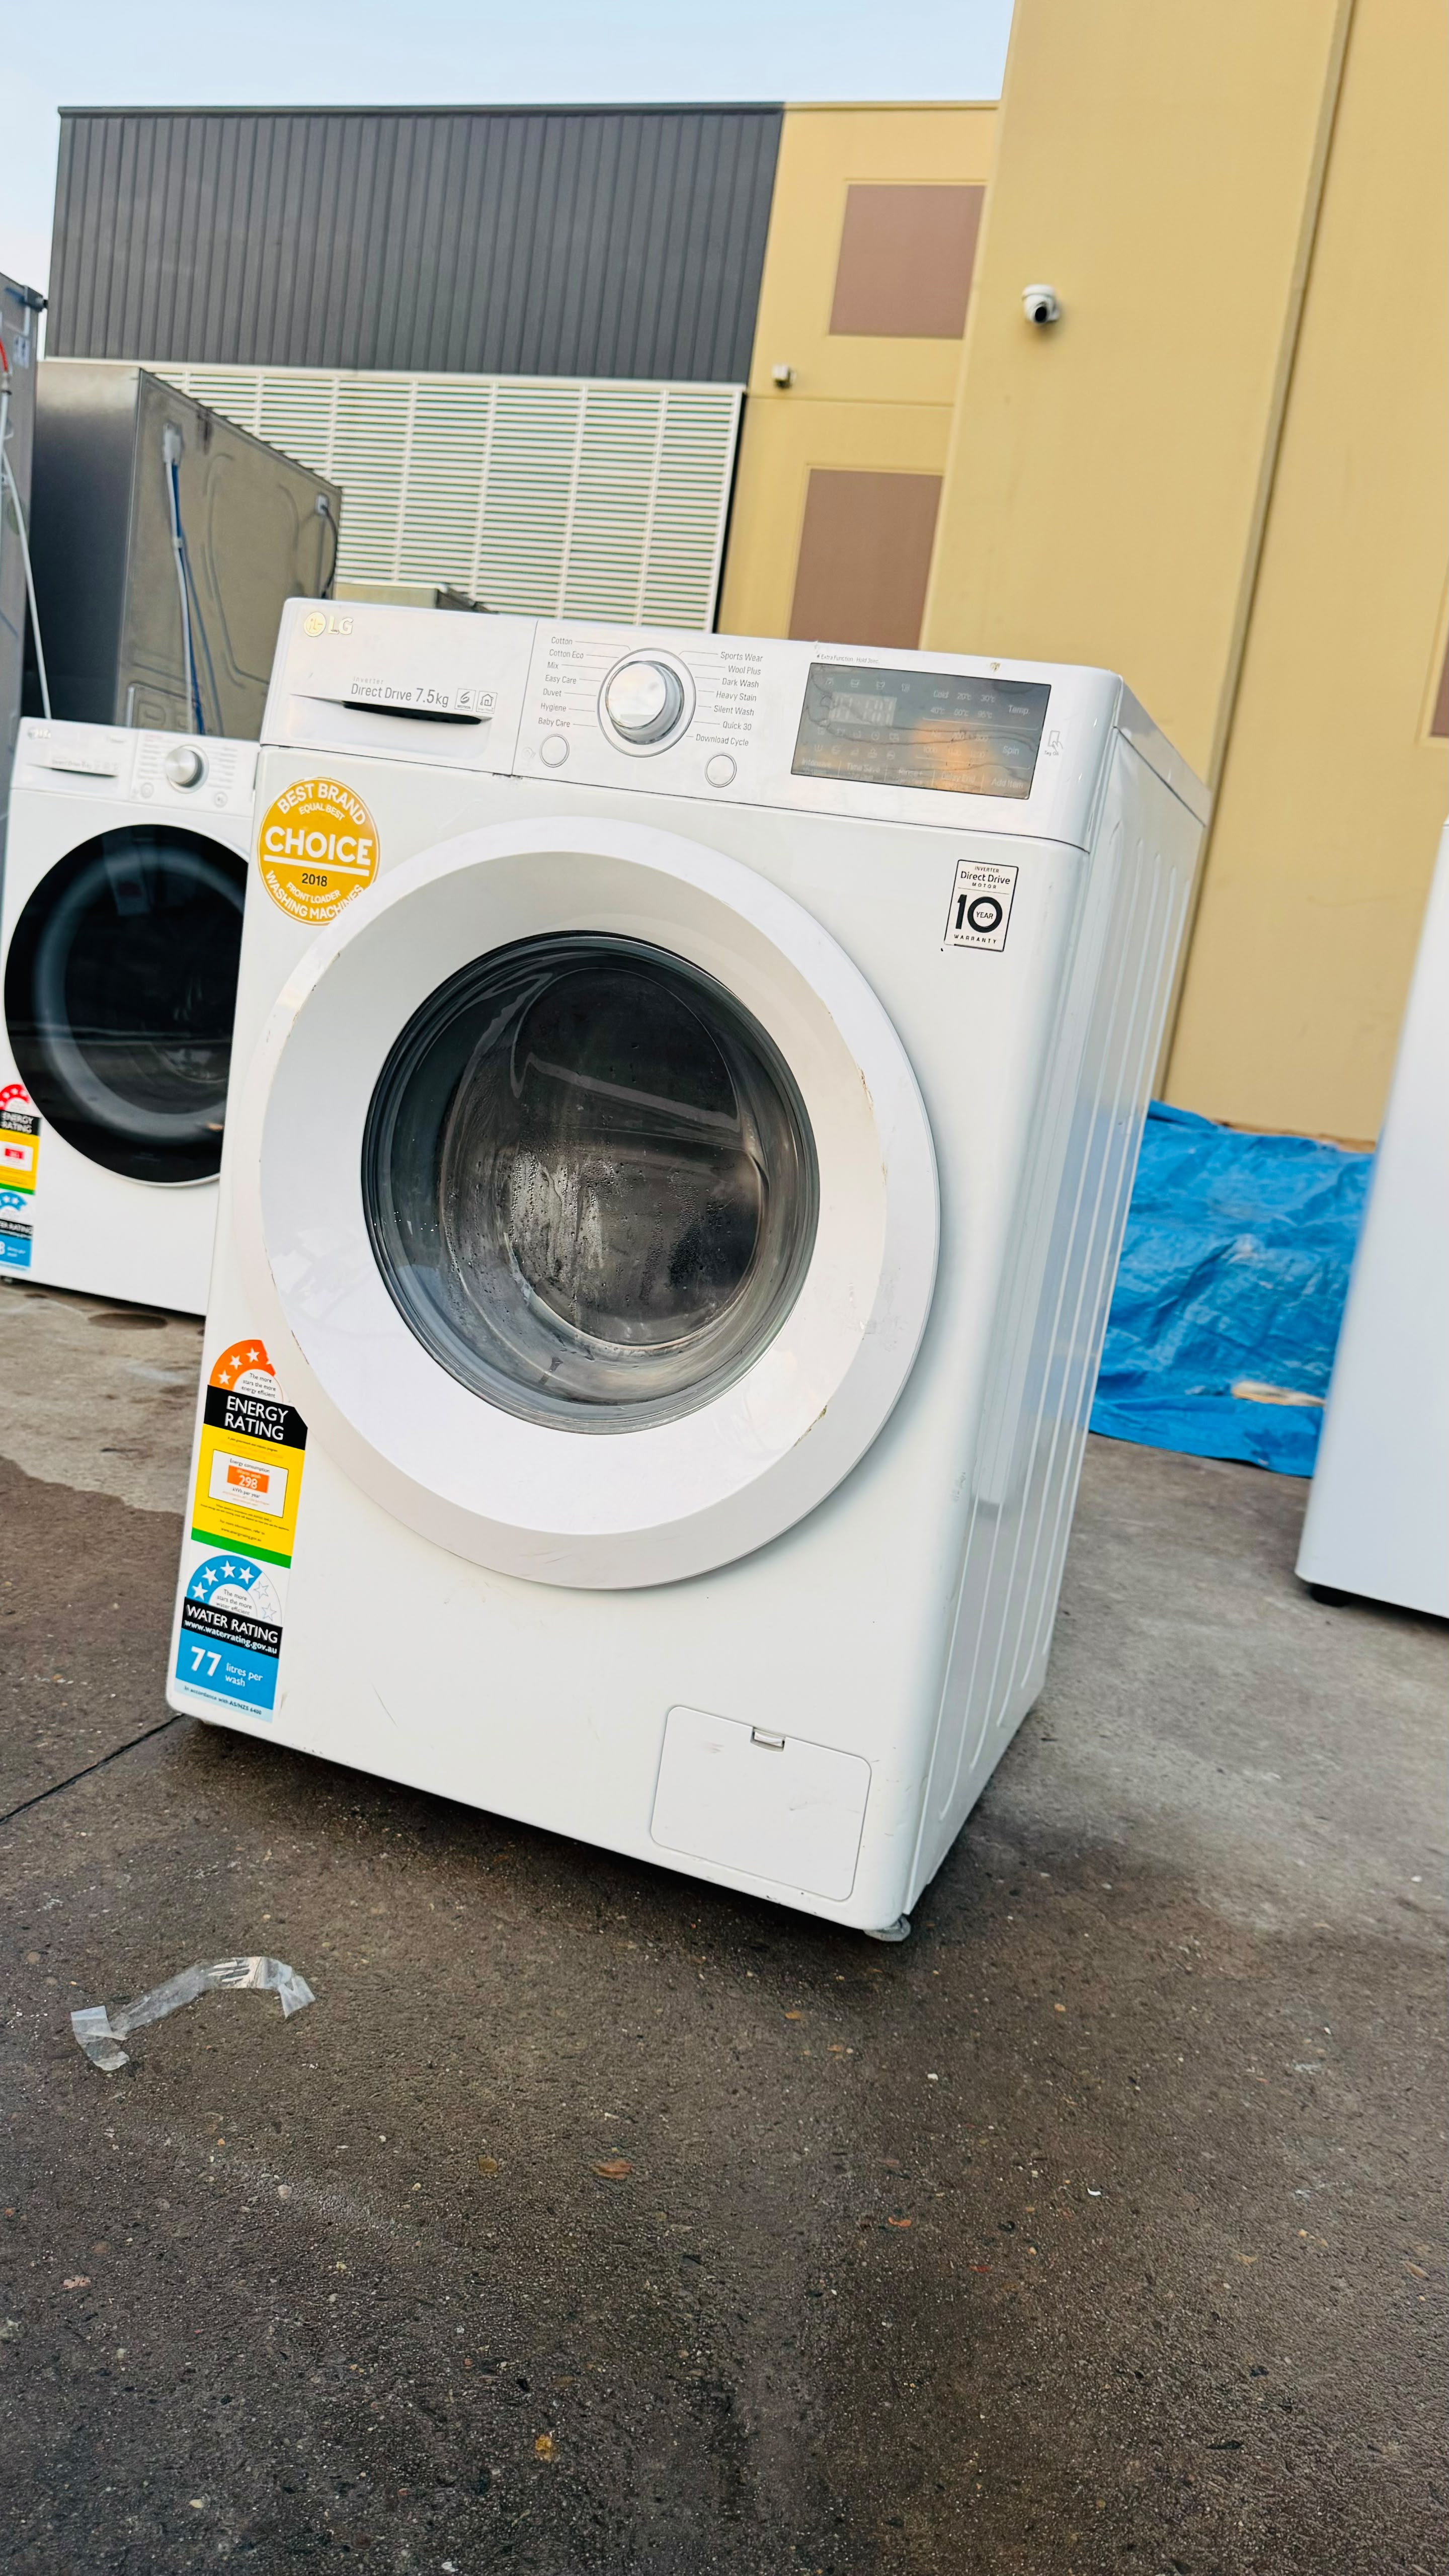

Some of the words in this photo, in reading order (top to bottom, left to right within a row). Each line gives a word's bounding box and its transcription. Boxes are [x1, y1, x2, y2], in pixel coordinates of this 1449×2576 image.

[328, 615, 354, 635] LG
[551, 637, 573, 645] Cotton
[549, 649, 571, 658] Cotton
[720, 652, 743, 661] Sports
[745, 654, 763, 662] Wear
[728, 665, 745, 674] Wool
[747, 667, 761, 675] Plus
[545, 675, 560, 683] Easy
[562, 676, 577, 684] Care
[722, 678, 738, 686] Dark
[740, 680, 759, 688] Wash
[351, 683, 382, 698] Direct
[385, 687, 412, 701] Drive
[543, 688, 561, 697] Duvet
[716, 691, 738, 701] Heavy
[739, 693, 757, 701] Stain
[933, 690, 949, 699] Cold
[541, 703, 567, 712] Hygiene
[714, 705, 733, 714] Silent
[735, 707, 754, 716] Wash
[538, 717, 554, 727] Baby
[555, 719, 571, 728] Care
[722, 721, 742, 730] Quick
[696, 734, 729, 744] Download
[731, 738, 749, 747] Cycle
[1002, 746, 1019, 756] Spin
[991, 778, 1006, 786] Add
[1007, 779, 1023, 789] Item
[277, 783, 314, 814] BEST
[318, 783, 366, 825] BRAND
[299, 802, 325, 815] EQUAL
[326, 804, 345, 821] BEST
[265, 826, 372, 866] CHOICE
[302, 873, 328, 887] 2018
[960, 871, 986, 881] Direct
[988, 874, 1010, 884] Drive
[266, 870, 308, 917] WASHING
[309, 884, 364, 920] MACHINES
[286, 881, 310, 902] FRONT
[310, 890, 341, 904] LOADER
[955, 894, 1003, 933] 10
[976, 911, 993, 919] YEAR
[954, 934, 997, 944] WARRANTY
[242, 1386, 257, 1394] energy
[258, 1390, 276, 1398] efficient
[226, 1395, 288, 1423] ENERGY
[224, 1412, 284, 1441] RATING
[230, 1458, 243, 1467] Energy
[245, 1463, 270, 1473] consumption
[238, 1475, 258, 1489] 298
[231, 1606, 250, 1615] efficient
[186, 1604, 228, 1628] WATER
[231, 1619, 278, 1644] RATING
[184, 1620, 277, 1654] www.waterrating.gov.au
[191, 1646, 222, 1676] 77
[226, 1662, 246, 1676] litres
[248, 1671, 263, 1681] per
[225, 1675, 246, 1687] wash
